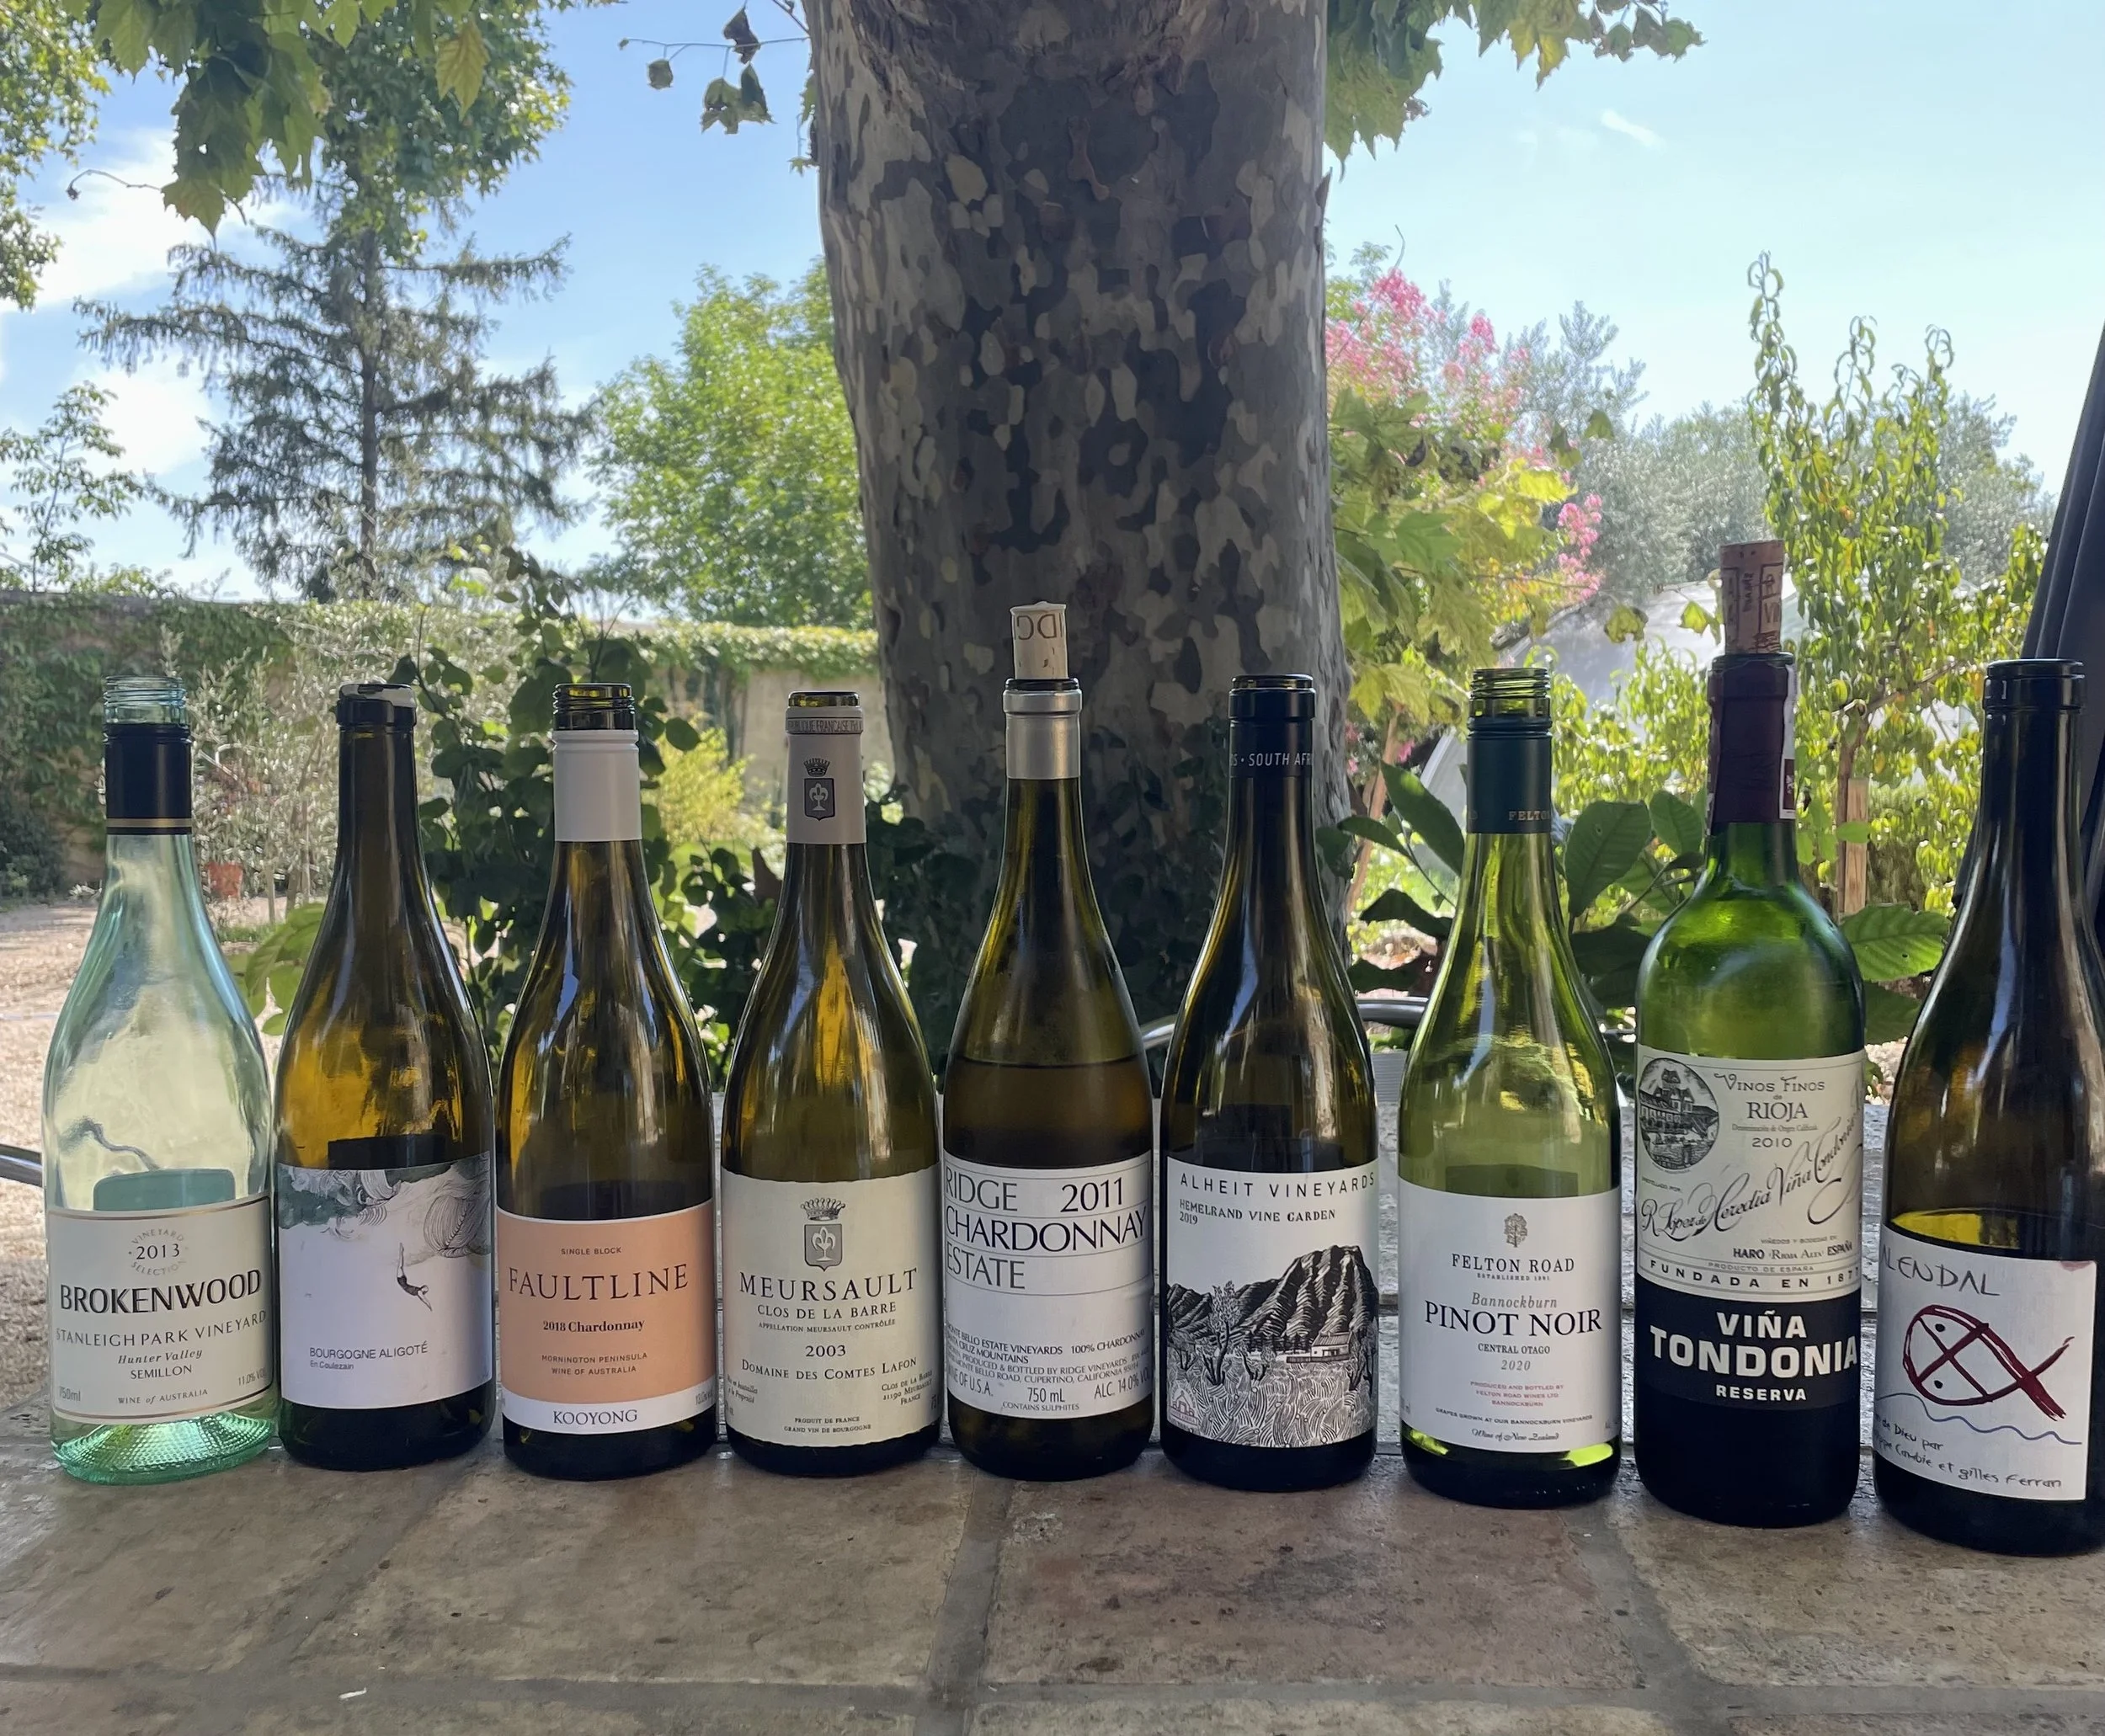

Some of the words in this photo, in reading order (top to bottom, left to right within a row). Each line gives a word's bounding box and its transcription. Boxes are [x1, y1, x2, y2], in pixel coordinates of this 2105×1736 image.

[1248, 753, 1290, 767] SOUTH
[1780, 1076, 1825, 1092] FINOS
[1746, 1101, 1809, 1122] RIOJA
[1752, 1137, 1793, 1148] 2010
[946, 1165, 1018, 1211] RIDGE
[1059, 1176, 1122, 1212] 2011
[1180, 1172, 1254, 1196] ALHEIT
[1269, 1171, 1375, 1198] VINEYARDS
[1179, 1198, 1243, 1220] HEMELRAND
[1249, 1211, 1281, 1222] VINE
[1287, 1209, 1336, 1222] GARDEN
[1179, 1211, 1198, 1225] 2019
[131, 1228, 184, 1244] VINEYARD
[946, 1205, 1147, 1253] CHARDONNAY
[136, 1243, 180, 1260] 2013
[594, 1246, 622, 1255] BLOCK
[1733, 1248, 1766, 1259] HARO
[946, 1240, 1026, 1290] ESTATE
[1452, 1254, 1520, 1273] FELTON
[1529, 1258, 1575, 1273] ROAD
[1708, 1262, 1759, 1272] PRODUCTO
[1650, 1259, 1760, 1288] FUNDADA
[1781, 1278, 1809, 1288] EN
[509, 1264, 689, 1301] FAULTLINE
[739, 1267, 918, 1302] MEURSAULT
[60, 1269, 262, 1314] BROKENWOOD
[1471, 1291, 1558, 1308] Bannockburn
[757, 1304, 790, 1318] CLOS
[797, 1308, 816, 1319] DE
[823, 1308, 843, 1319] LA
[850, 1301, 897, 1318] BARRE
[1425, 1300, 1519, 1337] PINOT
[1528, 1308, 1602, 1337] NOIR
[56, 1328, 136, 1347] STANLEIGH
[141, 1329, 189, 1346] PARK
[195, 1309, 267, 1339] VINEYARD
[543, 1319, 566, 1332] 2018
[568, 1319, 645, 1333] Chardonnay
[759, 1321, 804, 1333] APPELLATION
[1716, 1310, 1808, 1339] VIÑA
[309, 1346, 376, 1360] BOURGOGNE
[378, 1340, 429, 1358] ALIGOTÉ
[806, 1345, 846, 1357] 2003
[961, 1331, 980, 1346] BELLO
[981, 1339, 1009, 1352] ESTATE
[1010, 1344, 1063, 1355] VINEYARDS
[1071, 1344, 1095, 1355] 100%
[1478, 1343, 1519, 1354] CENTRAL
[1521, 1345, 1551, 1355] OTAGO
[1649, 1324, 1859, 1379] TONDONIA
[118, 1354, 162, 1365] Hunter
[165, 1349, 203, 1361] Valley
[541, 1355, 596, 1364] MORNINGTON
[599, 1352, 647, 1363] PENINSULA
[976, 1348, 1029, 1364] MOUNTAINS
[131, 1364, 192, 1380] SEMILLON
[552, 1367, 572, 1376] WINE
[588, 1366, 637, 1376] AUSTRALIA
[1007, 1365, 1045, 1375] BOTTLED
[1060, 1366, 1085, 1374] RIDGE
[1087, 1356, 1127, 1372] VINEYARDS
[1500, 1359, 1531, 1371] 2020
[959, 1371, 968, 1387] OF
[1077, 1369, 1122, 1382] CALIFORNIA
[118, 1396, 141, 1404] WINE
[146, 1395, 156, 1405] of
[159, 1388, 208, 1402] AUSTRALIA
[1026, 1387, 1047, 1403] 750
[1049, 1387, 1065, 1403] mL
[1715, 1384, 1807, 1402] RESERVA
[1002, 1401, 1040, 1412] CONTAINS
[1041, 1403, 1080, 1412] SULPHITES
[553, 1409, 638, 1426] KOOYONG
[1893, 1423, 1917, 1442] Dieu
[1921, 1438, 1944, 1451] par
[1938, 1462, 1955, 1474] et
[1958, 1467, 1999, 1483] gilles
